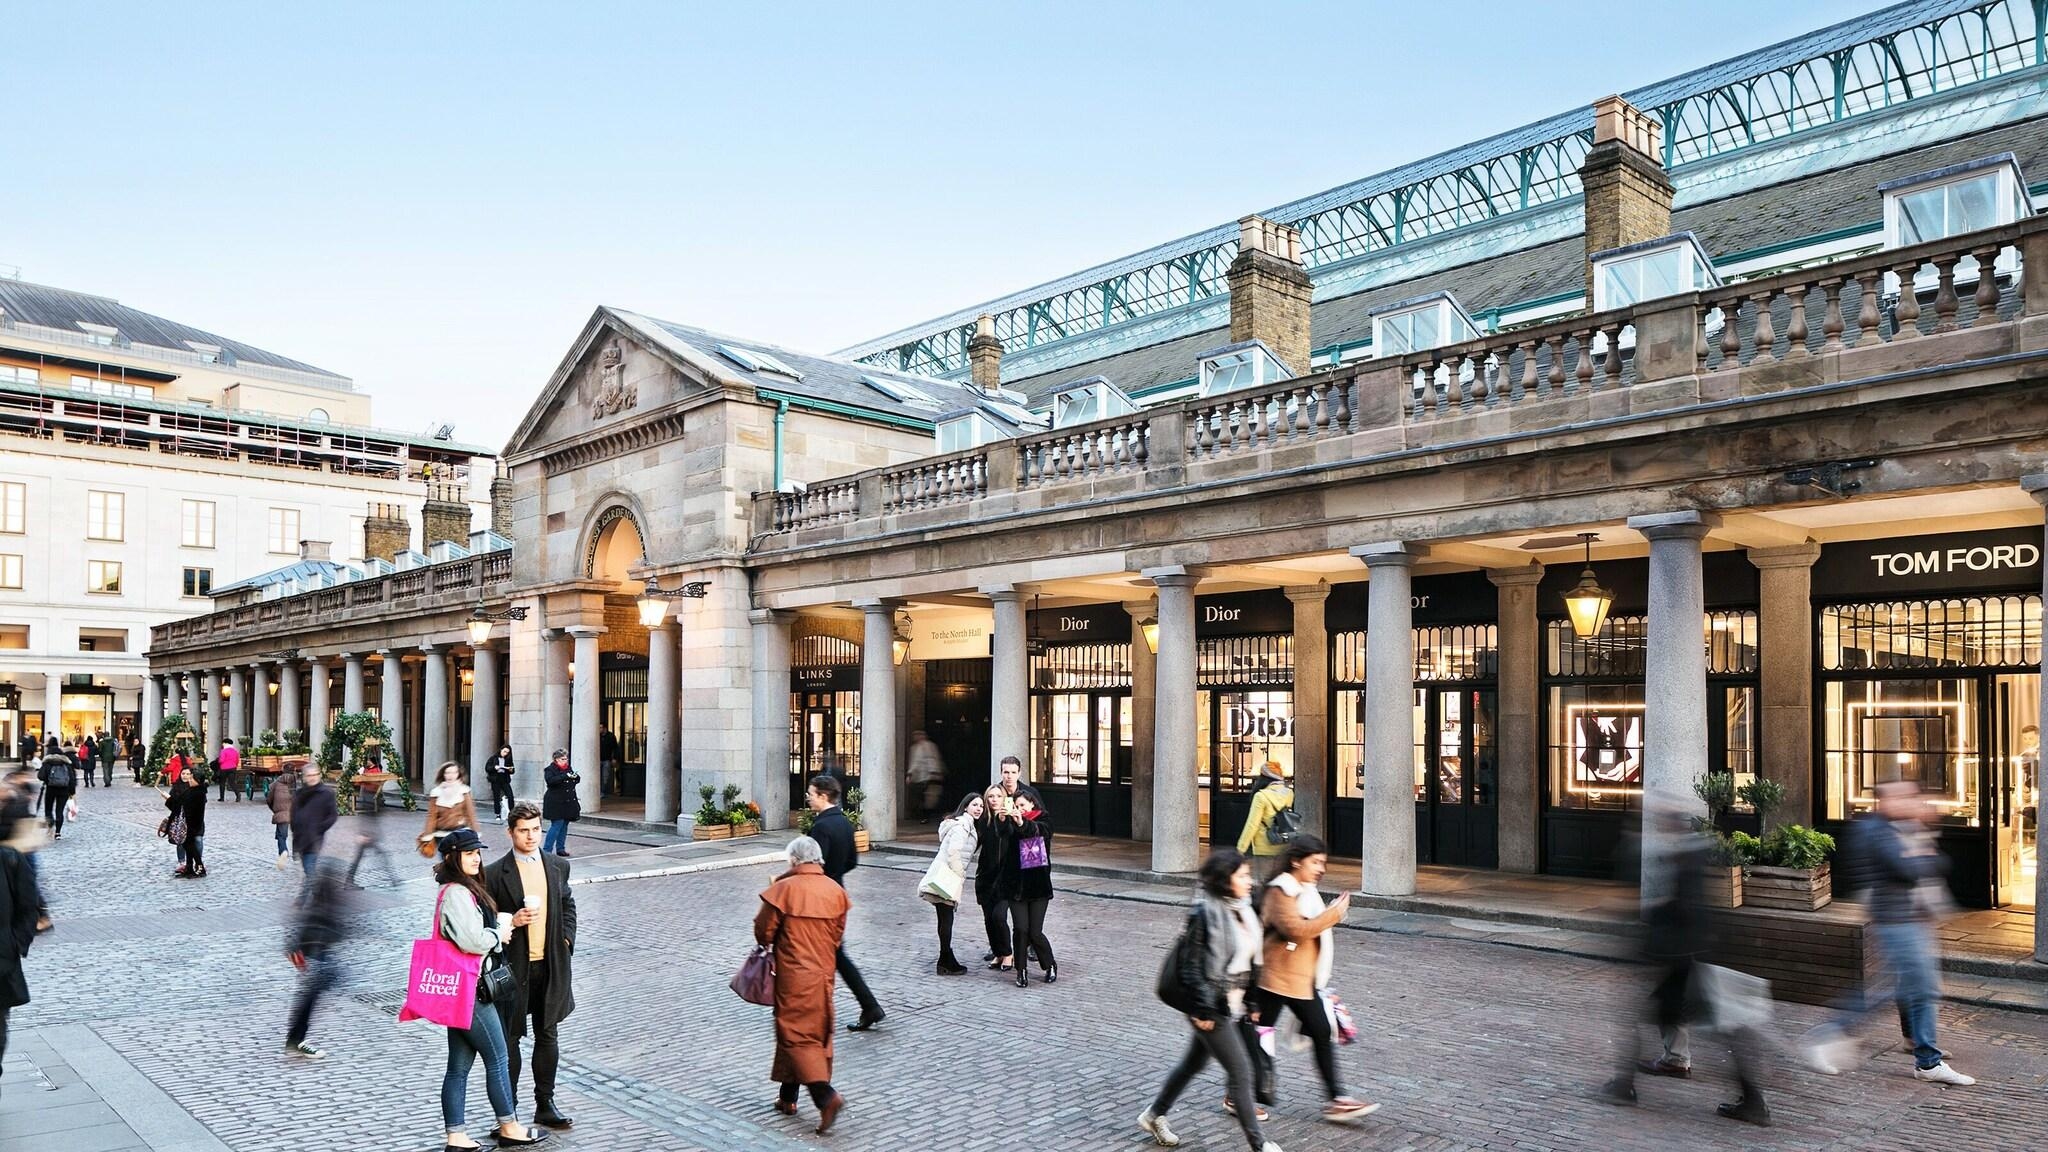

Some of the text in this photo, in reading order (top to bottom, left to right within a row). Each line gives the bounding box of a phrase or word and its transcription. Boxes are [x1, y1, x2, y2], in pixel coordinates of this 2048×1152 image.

[1870, 544, 2040, 577] TOM FORD
[1204, 605, 1241, 623] Dior
[1060, 616, 1090, 632] Dior
[931, 628, 982, 640] To the North Hall
[799, 669, 833, 680] LINKS
[1226, 707, 1295, 738] Dior
[421, 968, 460, 985] floral
[418, 983, 458, 996] street
